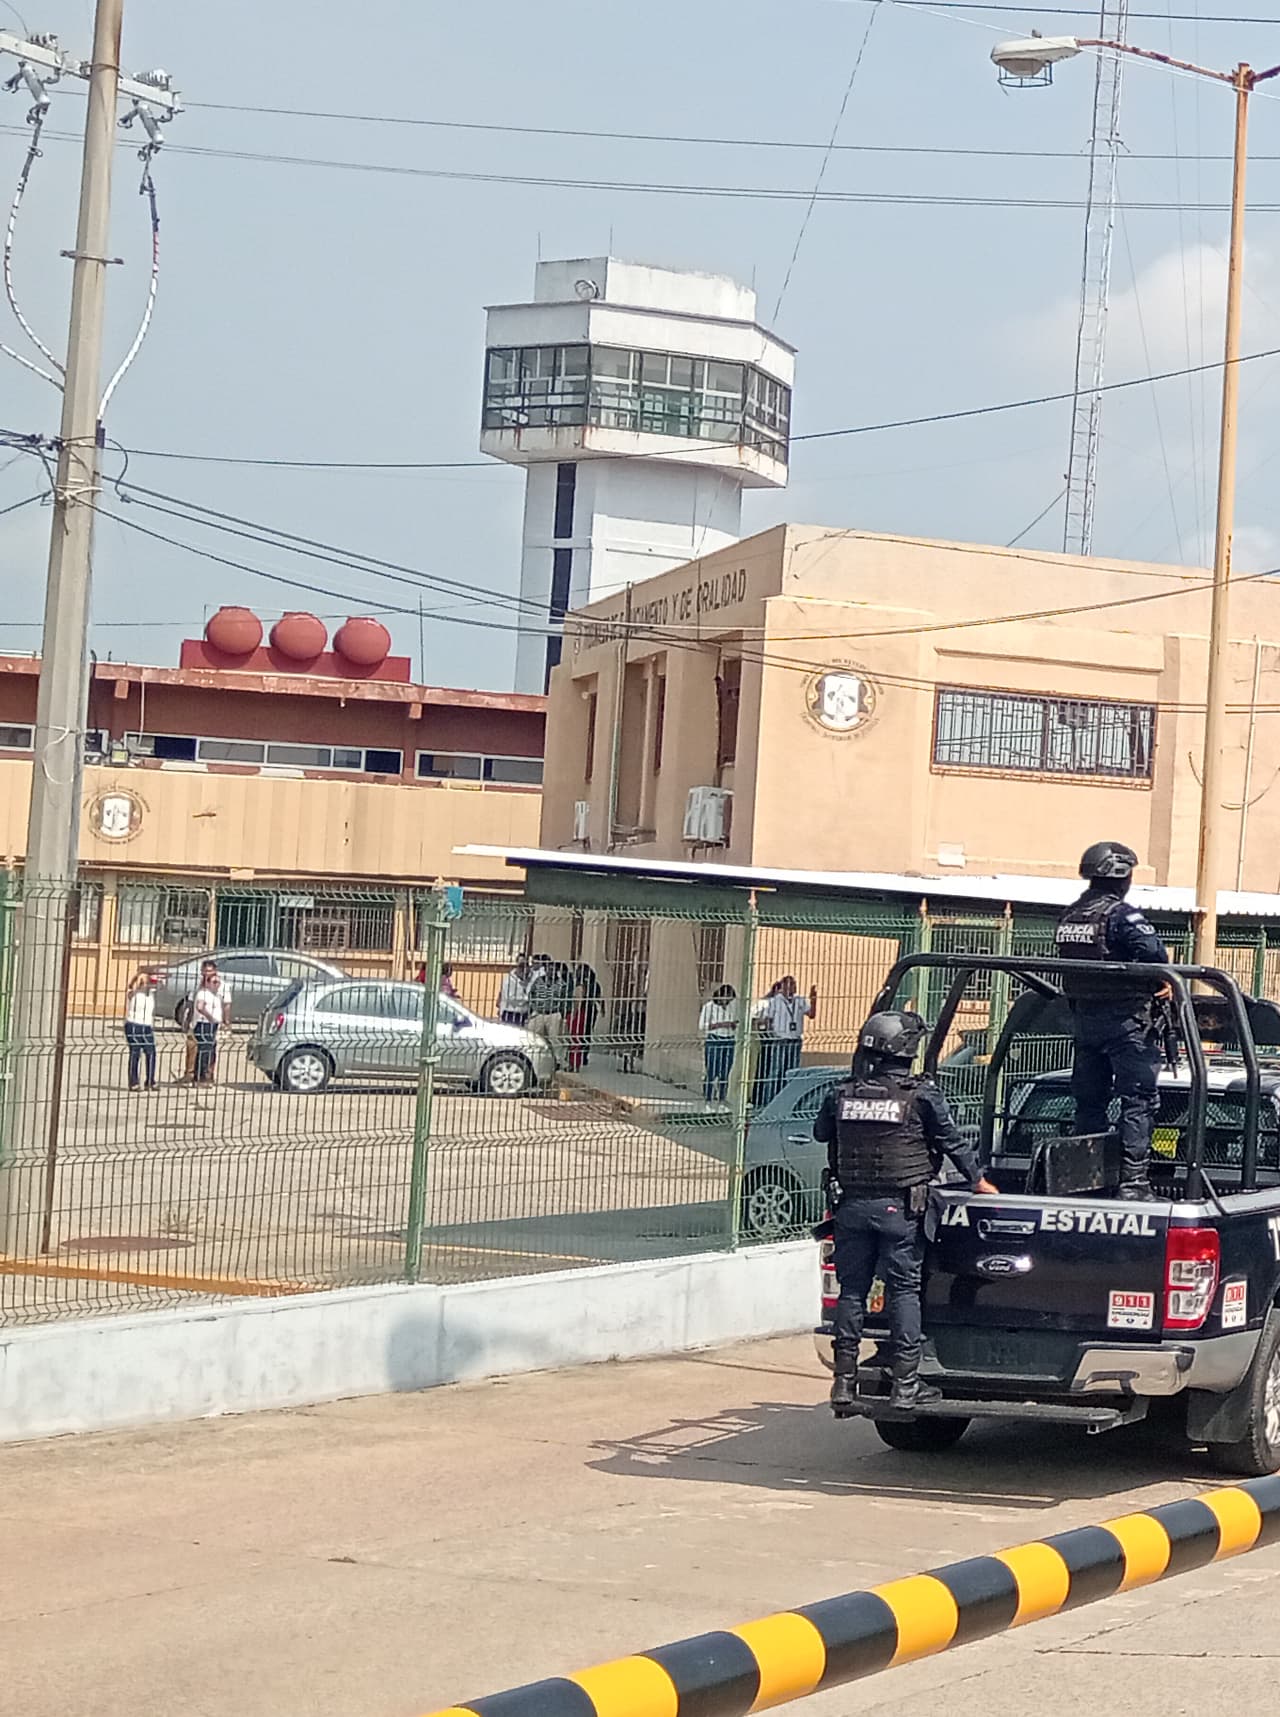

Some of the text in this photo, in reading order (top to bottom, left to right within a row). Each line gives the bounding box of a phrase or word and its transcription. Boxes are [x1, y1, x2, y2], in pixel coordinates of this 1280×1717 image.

[696, 568, 746, 614] ORALIDAD
[843, 1100, 900, 1112] POLICÍA
[841, 1110, 899, 1121] ESTATAL
[1040, 1210, 1157, 1236] ESTATAL
[1113, 1295, 1149, 1307] 911
